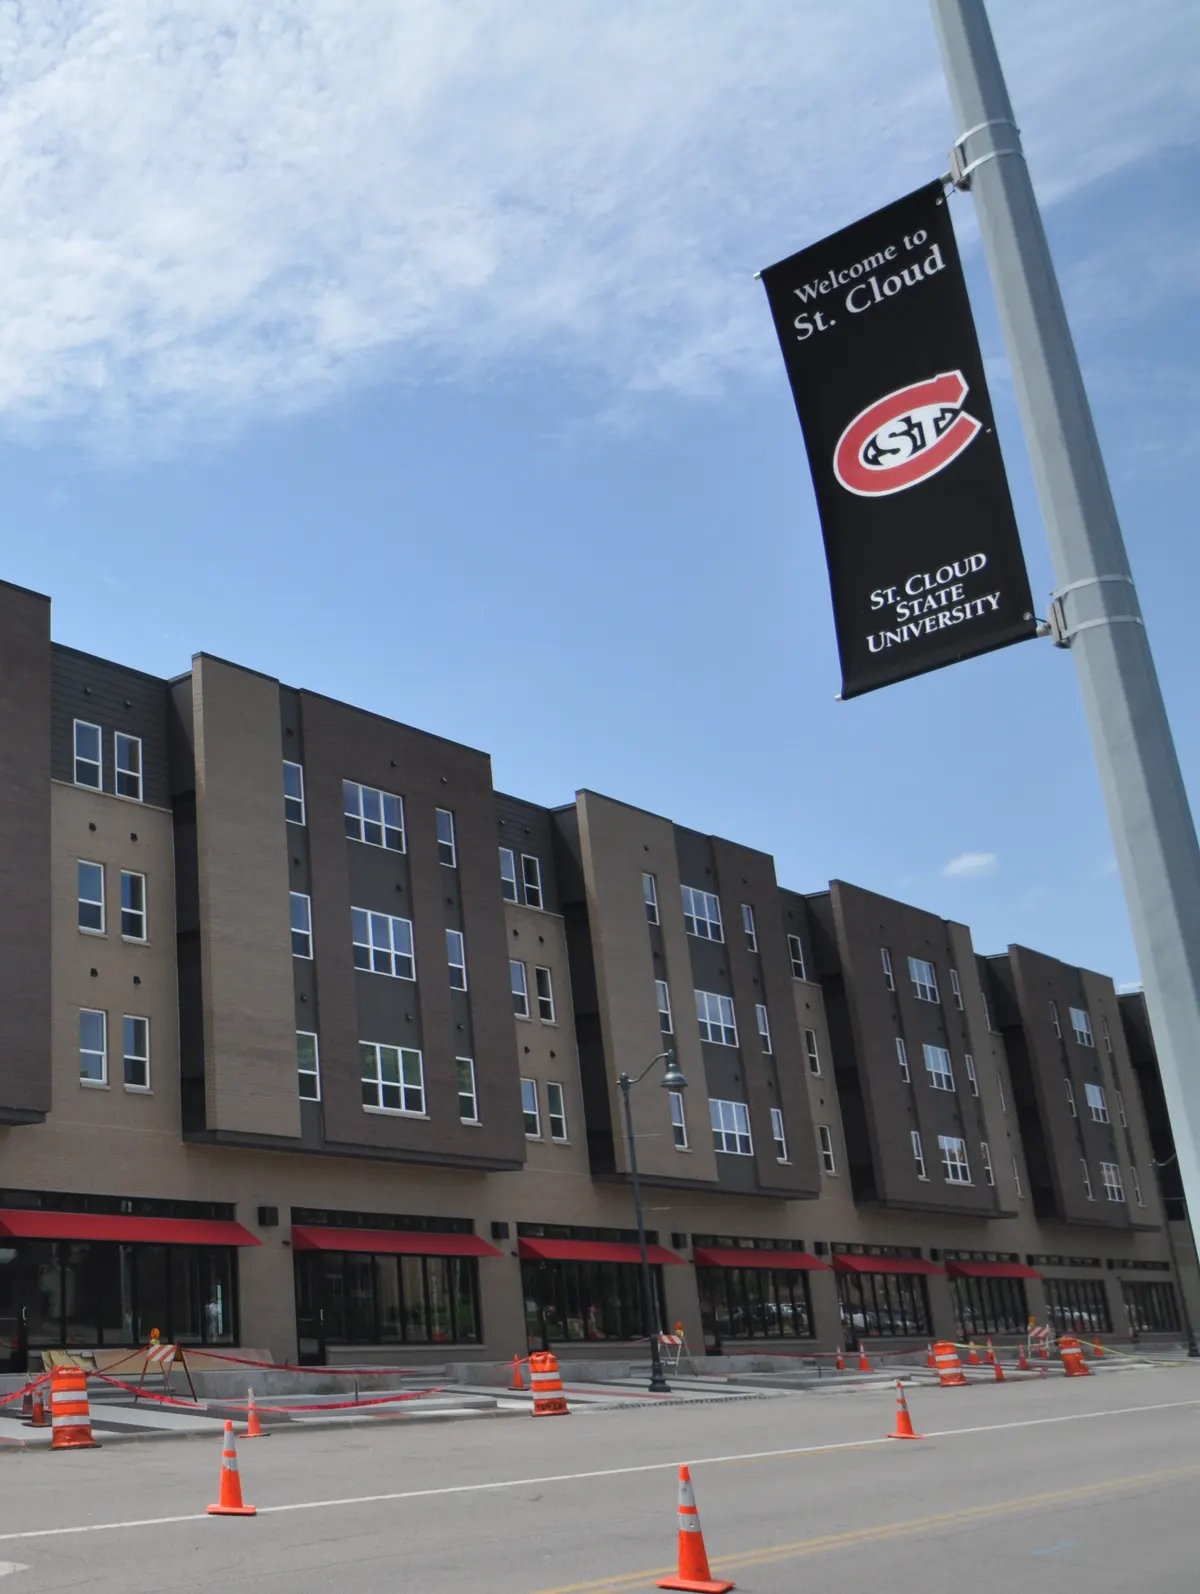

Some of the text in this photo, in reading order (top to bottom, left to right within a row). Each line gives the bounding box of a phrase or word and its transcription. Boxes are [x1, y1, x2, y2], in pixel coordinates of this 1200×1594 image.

[793, 229, 928, 304] Welcome to
[793, 243, 947, 341] St. Cloud
[870, 553, 987, 610] ST. CLOUD
[896, 583, 965, 622] STATE
[865, 592, 1000, 653] UNIVERSITY
